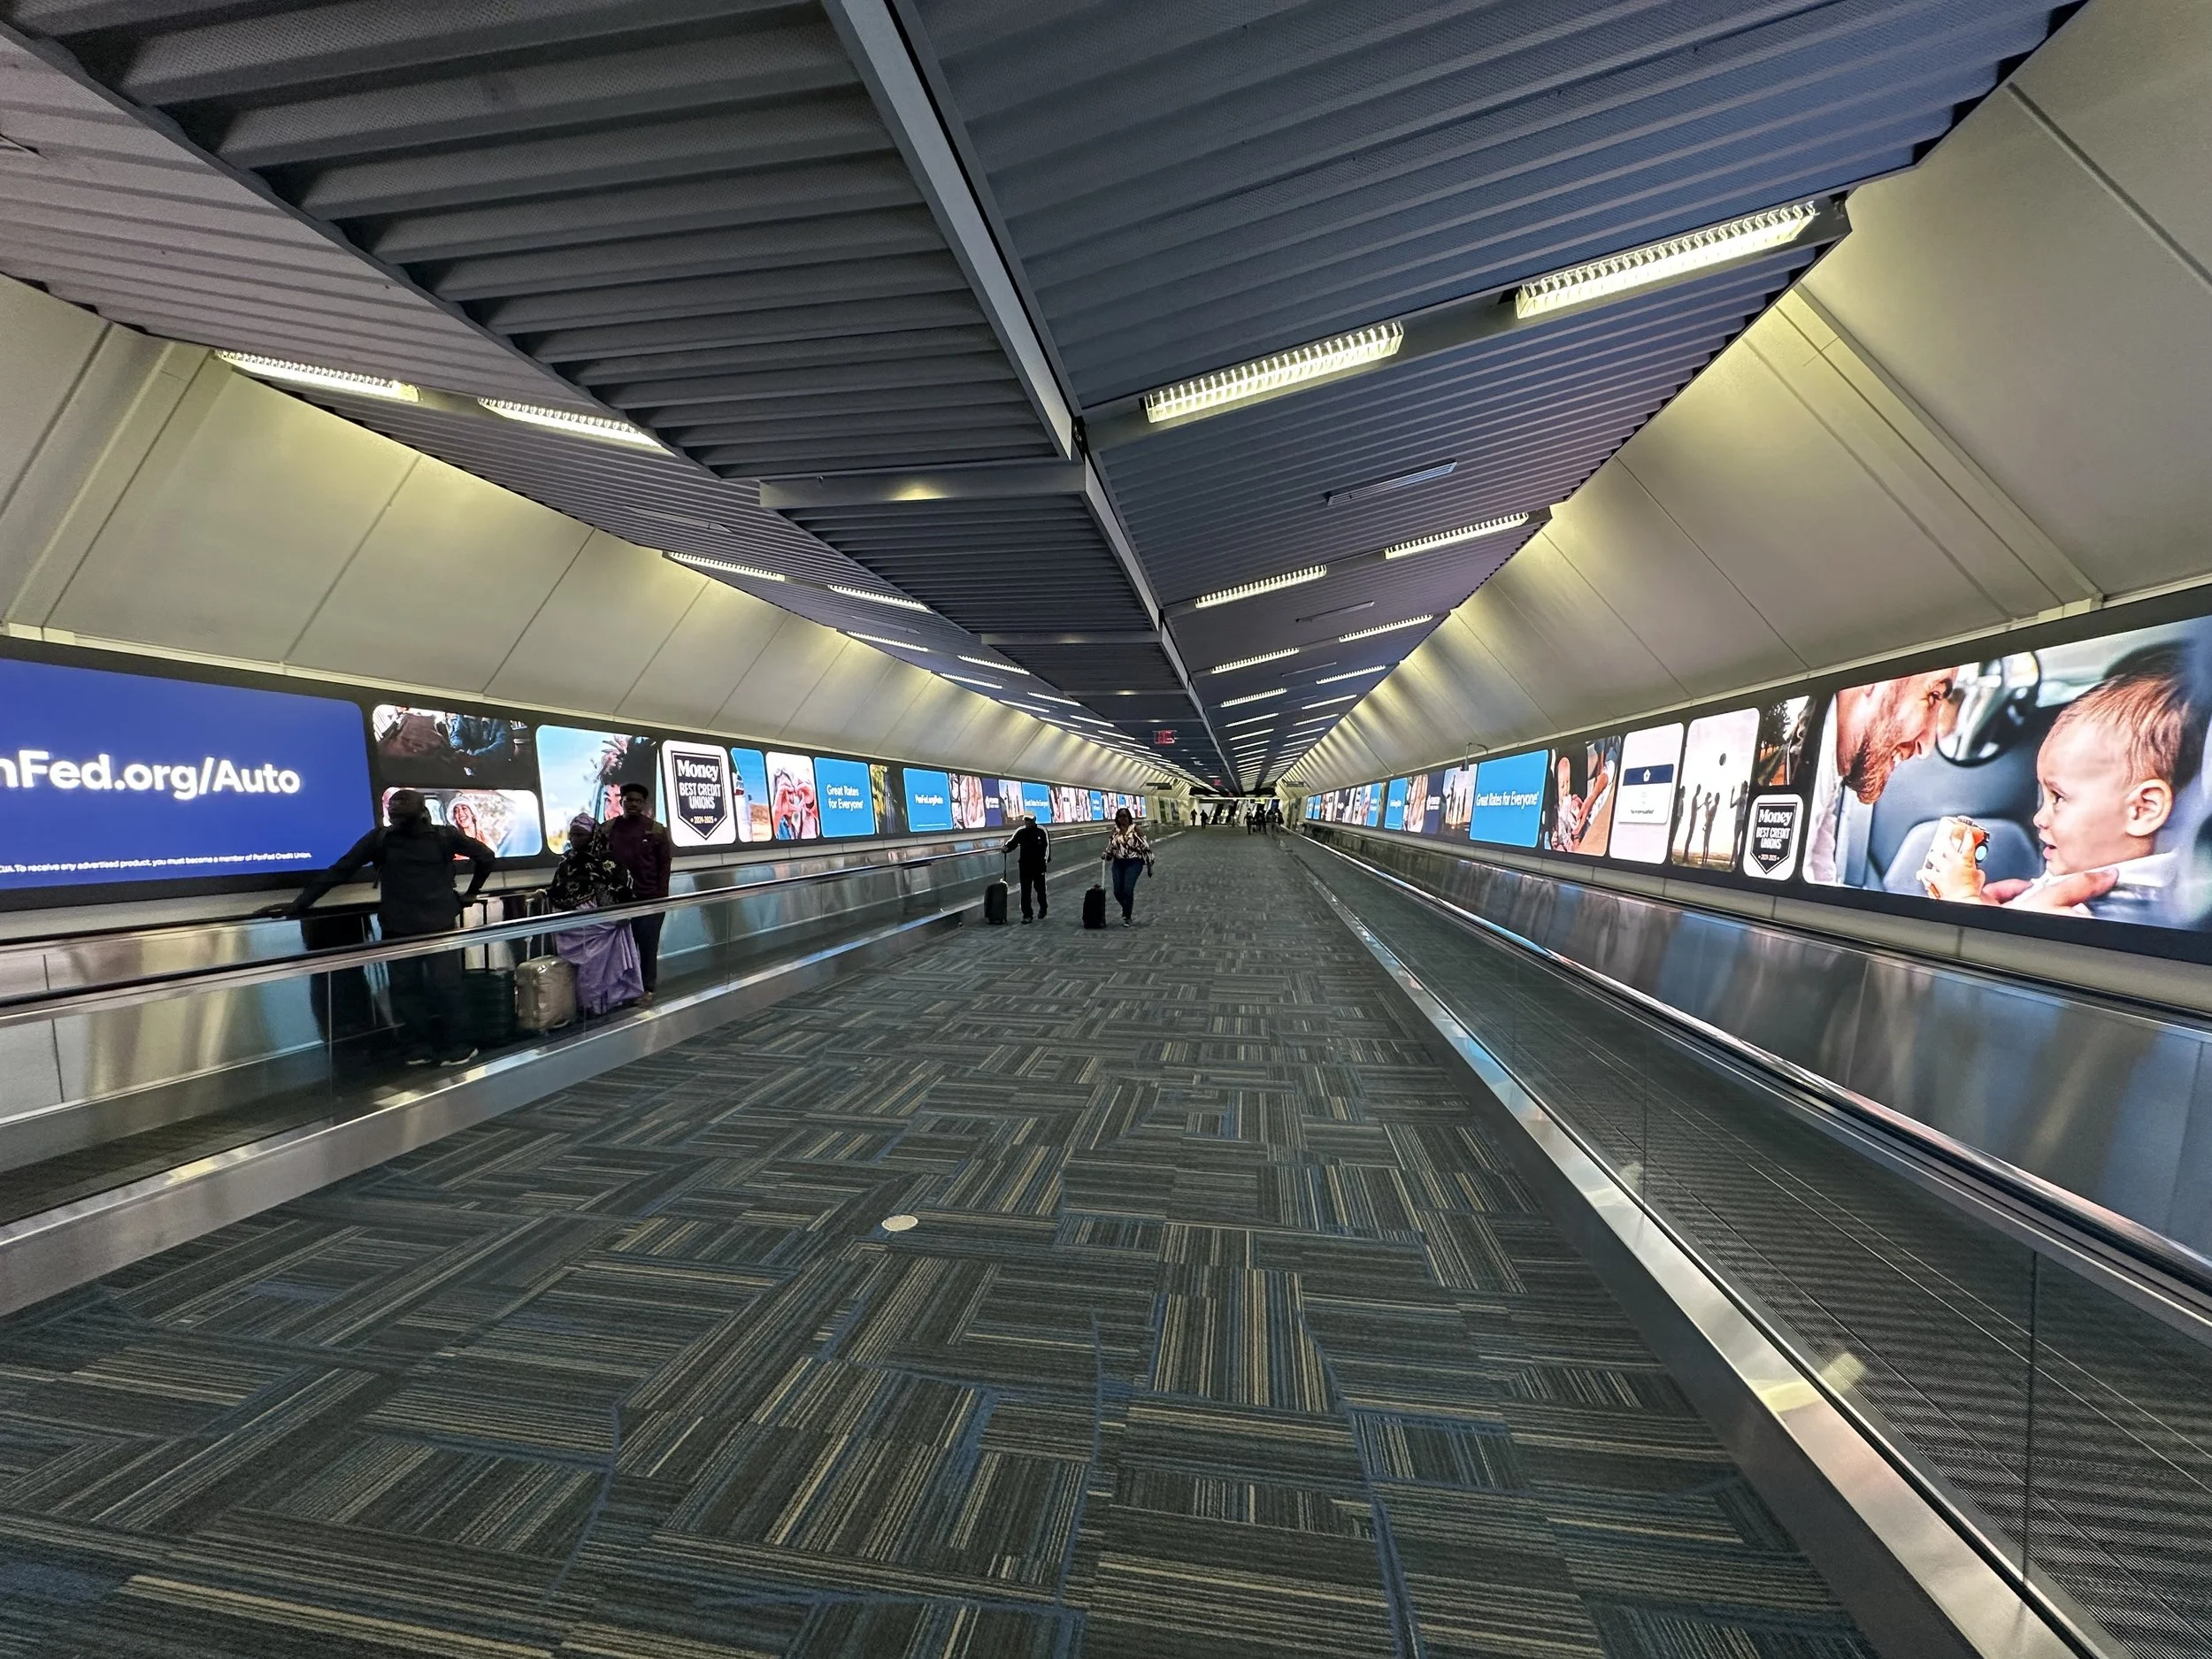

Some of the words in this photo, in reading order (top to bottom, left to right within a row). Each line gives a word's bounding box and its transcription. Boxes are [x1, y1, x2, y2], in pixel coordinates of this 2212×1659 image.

[676, 759, 718, 782] Money
[679, 782, 697, 796] BEST
[697, 783, 721, 797] CREDIT
[826, 784, 843, 796] Great
[843, 785, 859, 796] Rates
[688, 795, 715, 809] UNIONS
[828, 797, 837, 809] for
[1476, 793, 1488, 807] Great
[1489, 792, 1502, 806] Rates
[1758, 809, 1793, 826] Money
[1755, 826, 1770, 838] BEST
[1770, 827, 1791, 839] CREDIT
[1760, 837, 1782, 849] UNIONS
[14, 864, 27, 872] To
[61, 863, 76, 872] any
[77, 860, 119, 870] advertised
